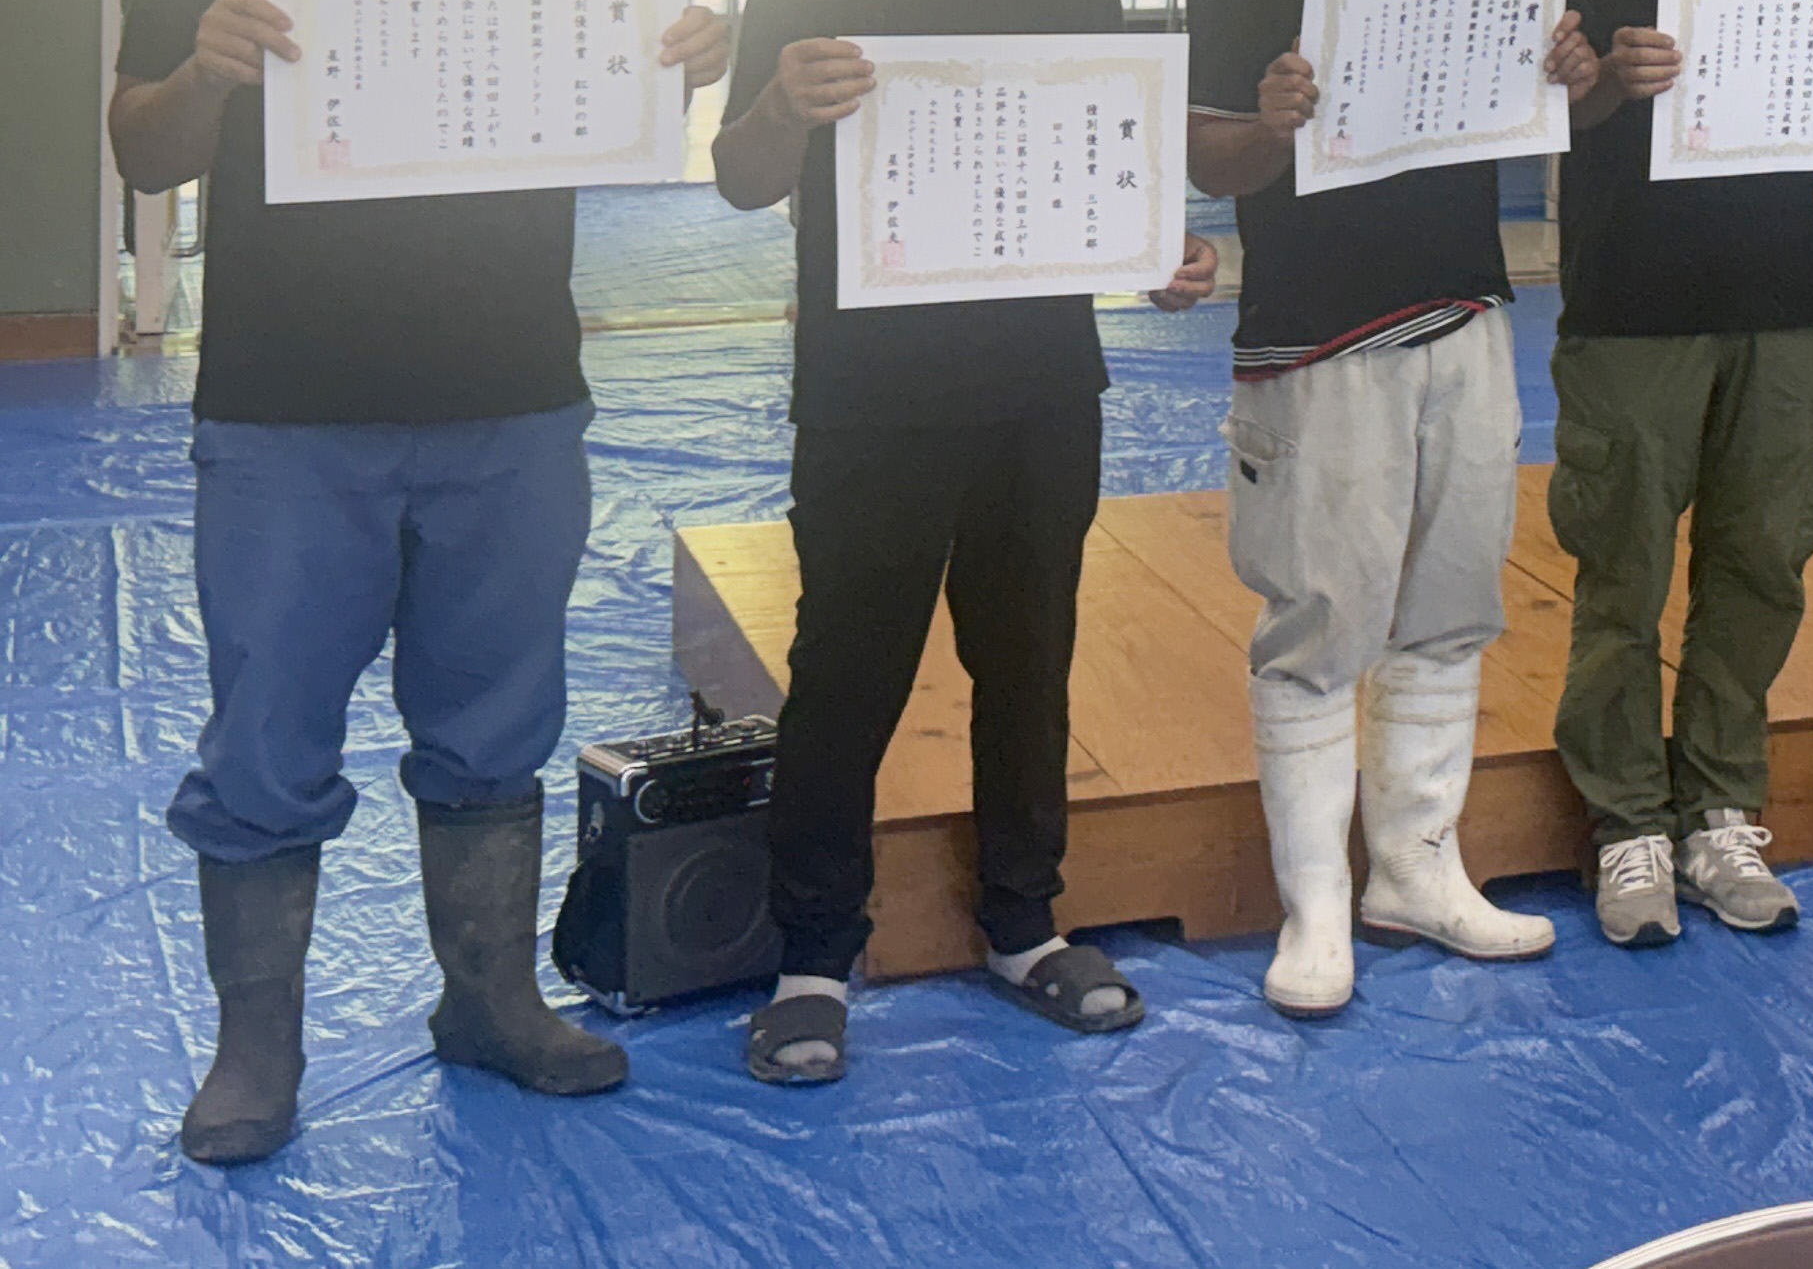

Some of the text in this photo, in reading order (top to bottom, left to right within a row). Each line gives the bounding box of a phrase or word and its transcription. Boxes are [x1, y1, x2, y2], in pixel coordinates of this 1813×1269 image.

[608, 0, 632, 75] 賞状
[1517, 3, 1539, 65] 賞状
[1116, 118, 1138, 189] 賞状
